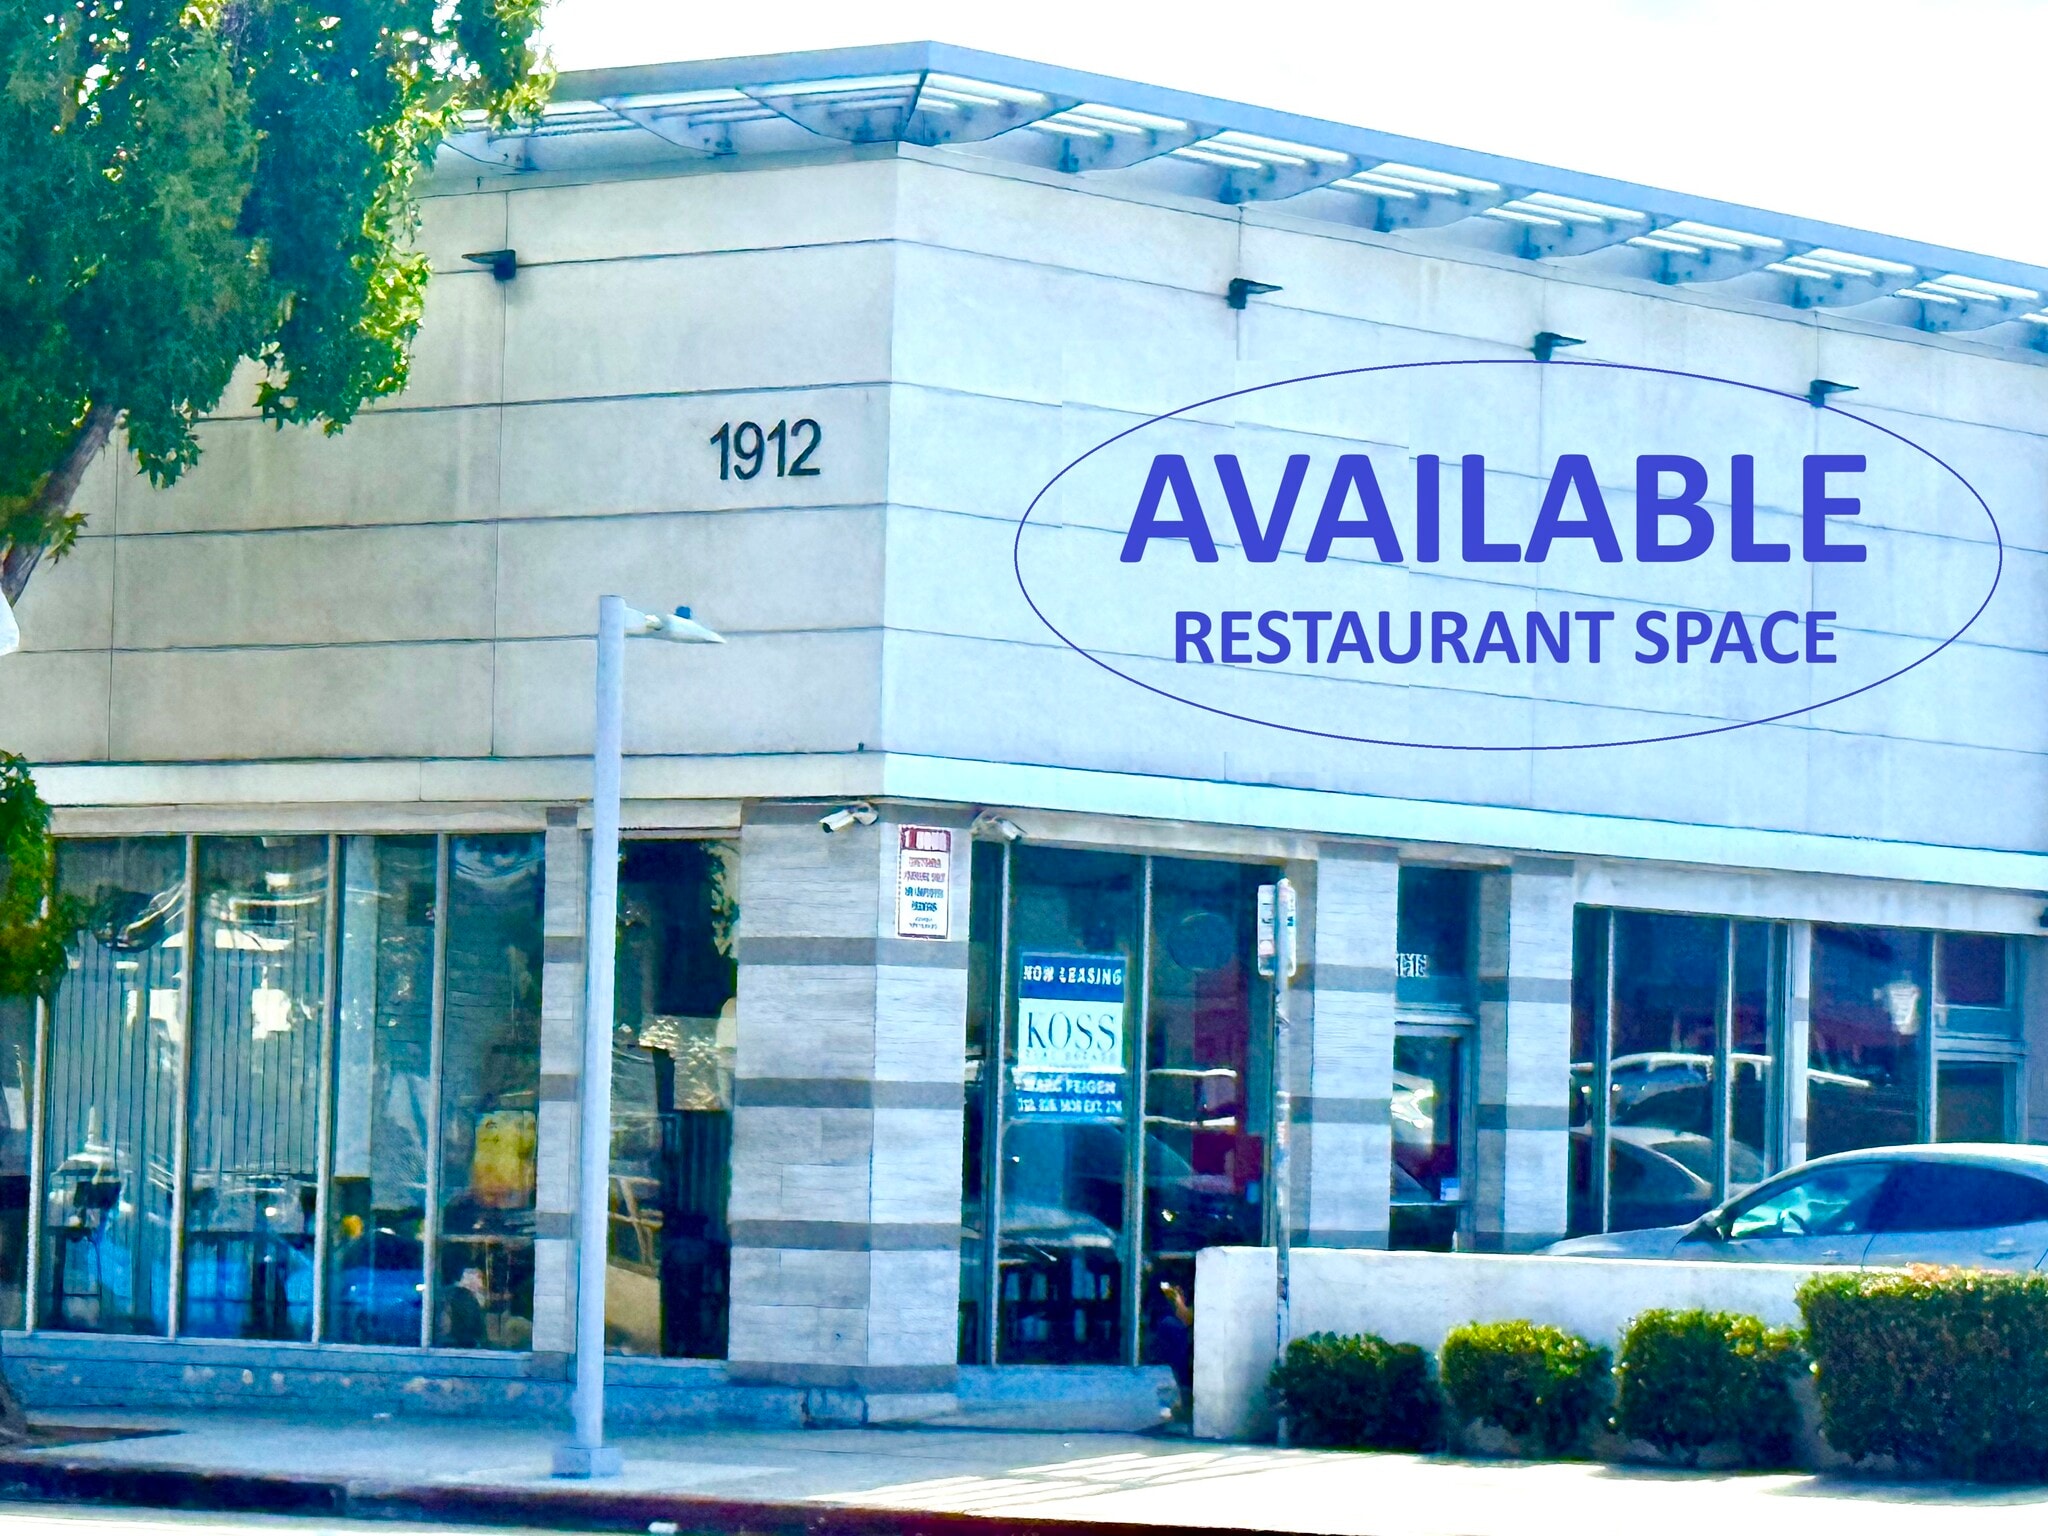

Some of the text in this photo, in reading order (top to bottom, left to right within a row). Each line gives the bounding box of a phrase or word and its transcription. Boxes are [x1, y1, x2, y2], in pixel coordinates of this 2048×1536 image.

[710, 418, 822, 481] 1912
[1023, 965, 1122, 985] NOW LEASING
[1027, 1011, 1115, 1051] KOSS
